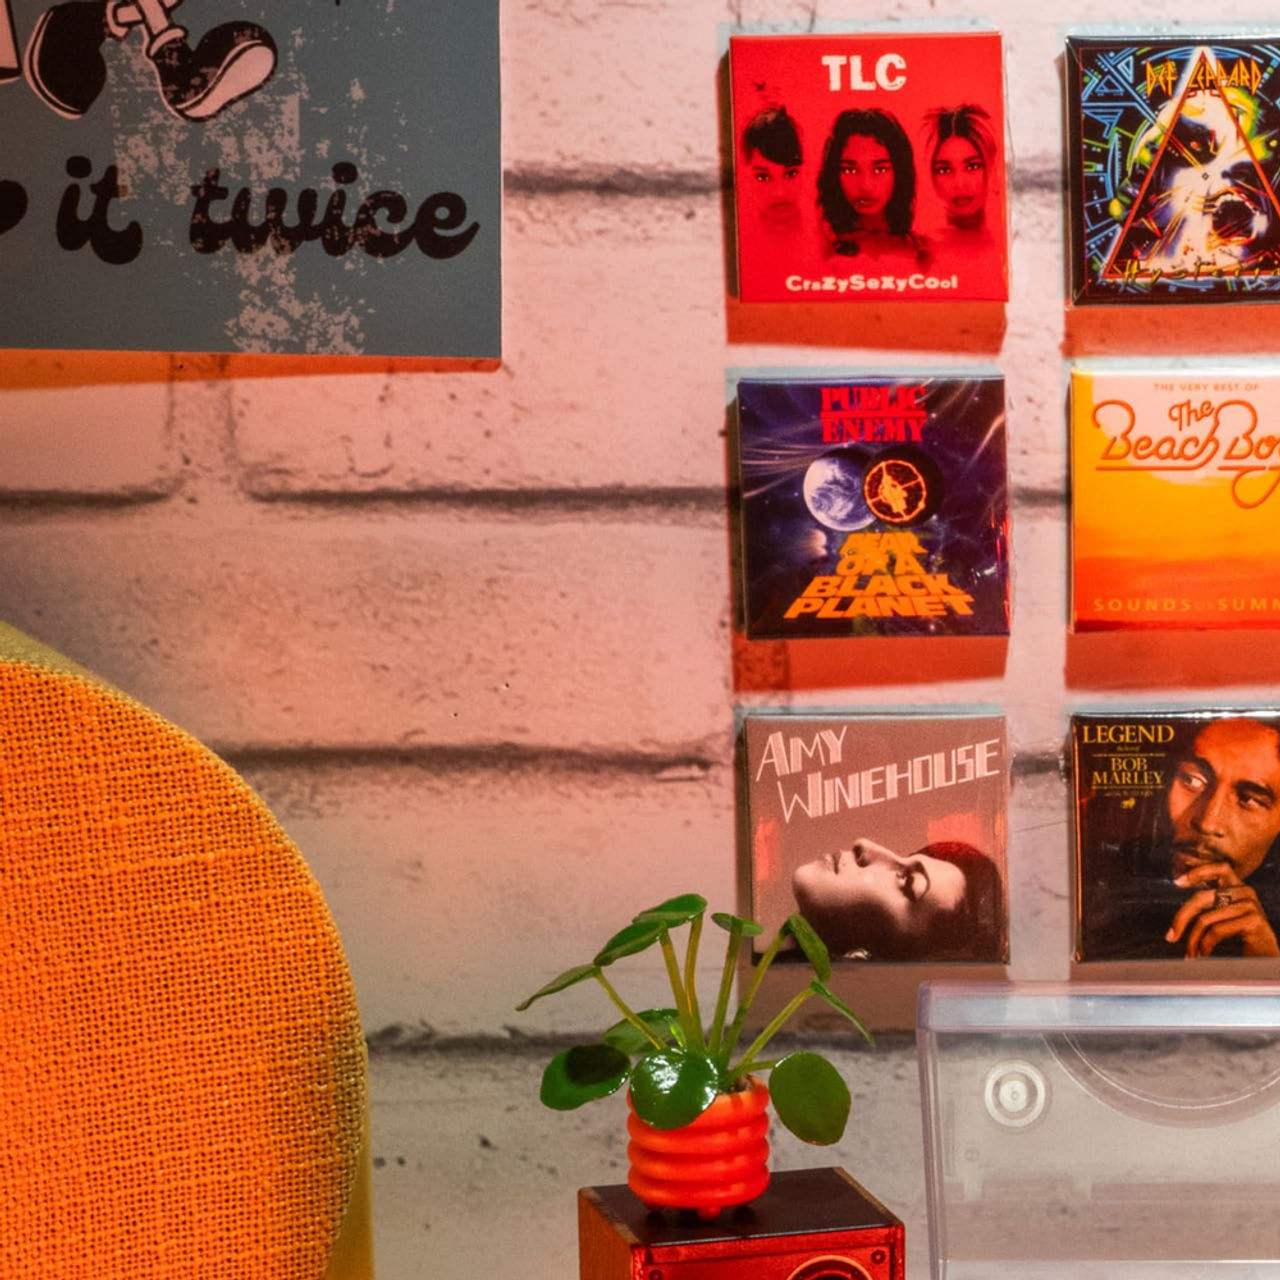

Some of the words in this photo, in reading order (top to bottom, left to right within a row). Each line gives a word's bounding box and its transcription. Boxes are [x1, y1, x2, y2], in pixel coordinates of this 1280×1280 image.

[821, 53, 907, 91] TLC
[1145, 57, 1178, 97] DEF
[1186, 55, 1262, 97] LEPPARD
[56, 155, 143, 264] it
[189, 161, 480, 260] twice
[820, 386, 927, 412] PUBLIC
[1153, 383, 1174, 392] THE
[1179, 383, 1209, 392] VERY
[1213, 383, 1240, 392] BEST
[1244, 383, 1261, 392] OF
[1168, 399, 1216, 432] The
[821, 417, 927, 443] ENEMY
[1091, 399, 1221, 471] Beach
[801, 574, 966, 598] BLACK
[783, 595, 975, 619] PLANET
[1094, 598, 1192, 612] SOUNDS
[1083, 724, 1175, 744] LEGEND
[756, 725, 847, 781] AMY
[1111, 757, 1148, 771] BOB
[777, 738, 1000, 824] WINEHOUSE
[1092, 771, 1165, 785] MARLEY
